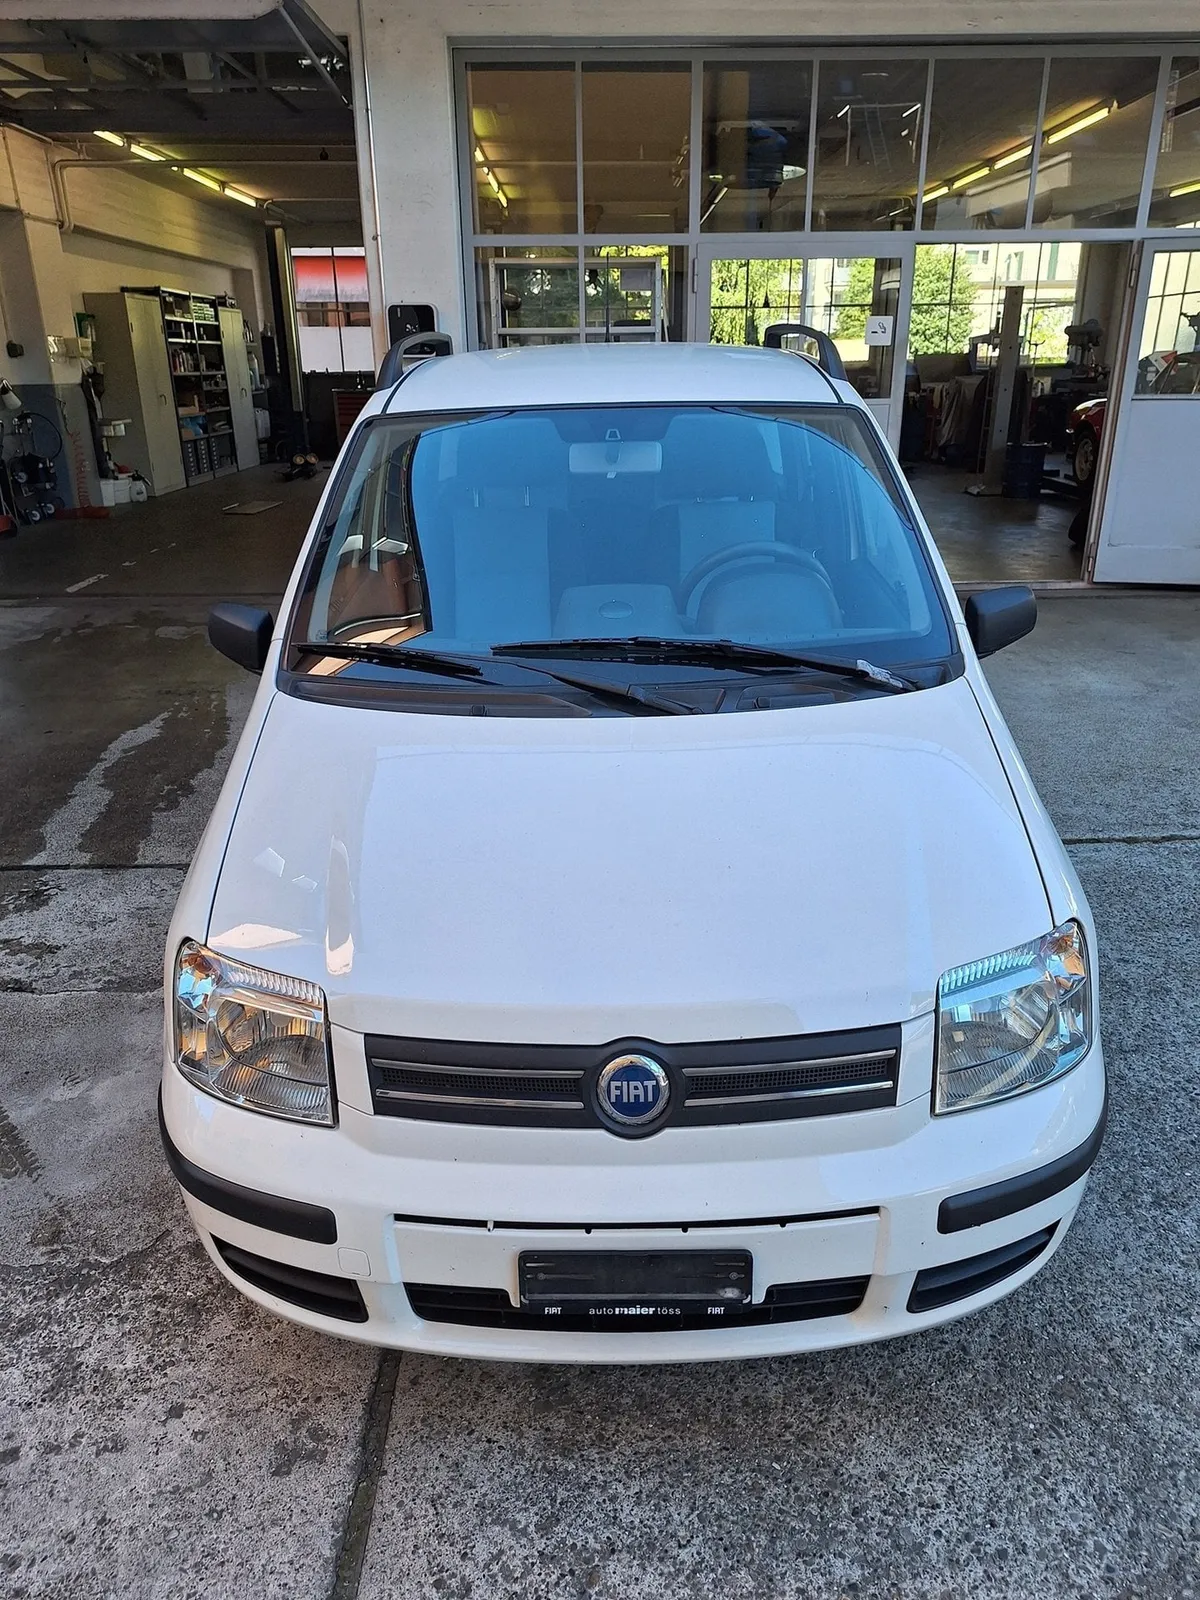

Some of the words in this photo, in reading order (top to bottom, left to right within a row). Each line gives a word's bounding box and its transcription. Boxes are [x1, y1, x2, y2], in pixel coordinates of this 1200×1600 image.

[610, 1081, 656, 1103] FIAT
[544, 1306, 562, 1315] FIAT
[588, 1306, 614, 1315] auto
[614, 1304, 656, 1315] maier
[657, 1306, 681, 1315] töss
[707, 1306, 725, 1315] FIAT
